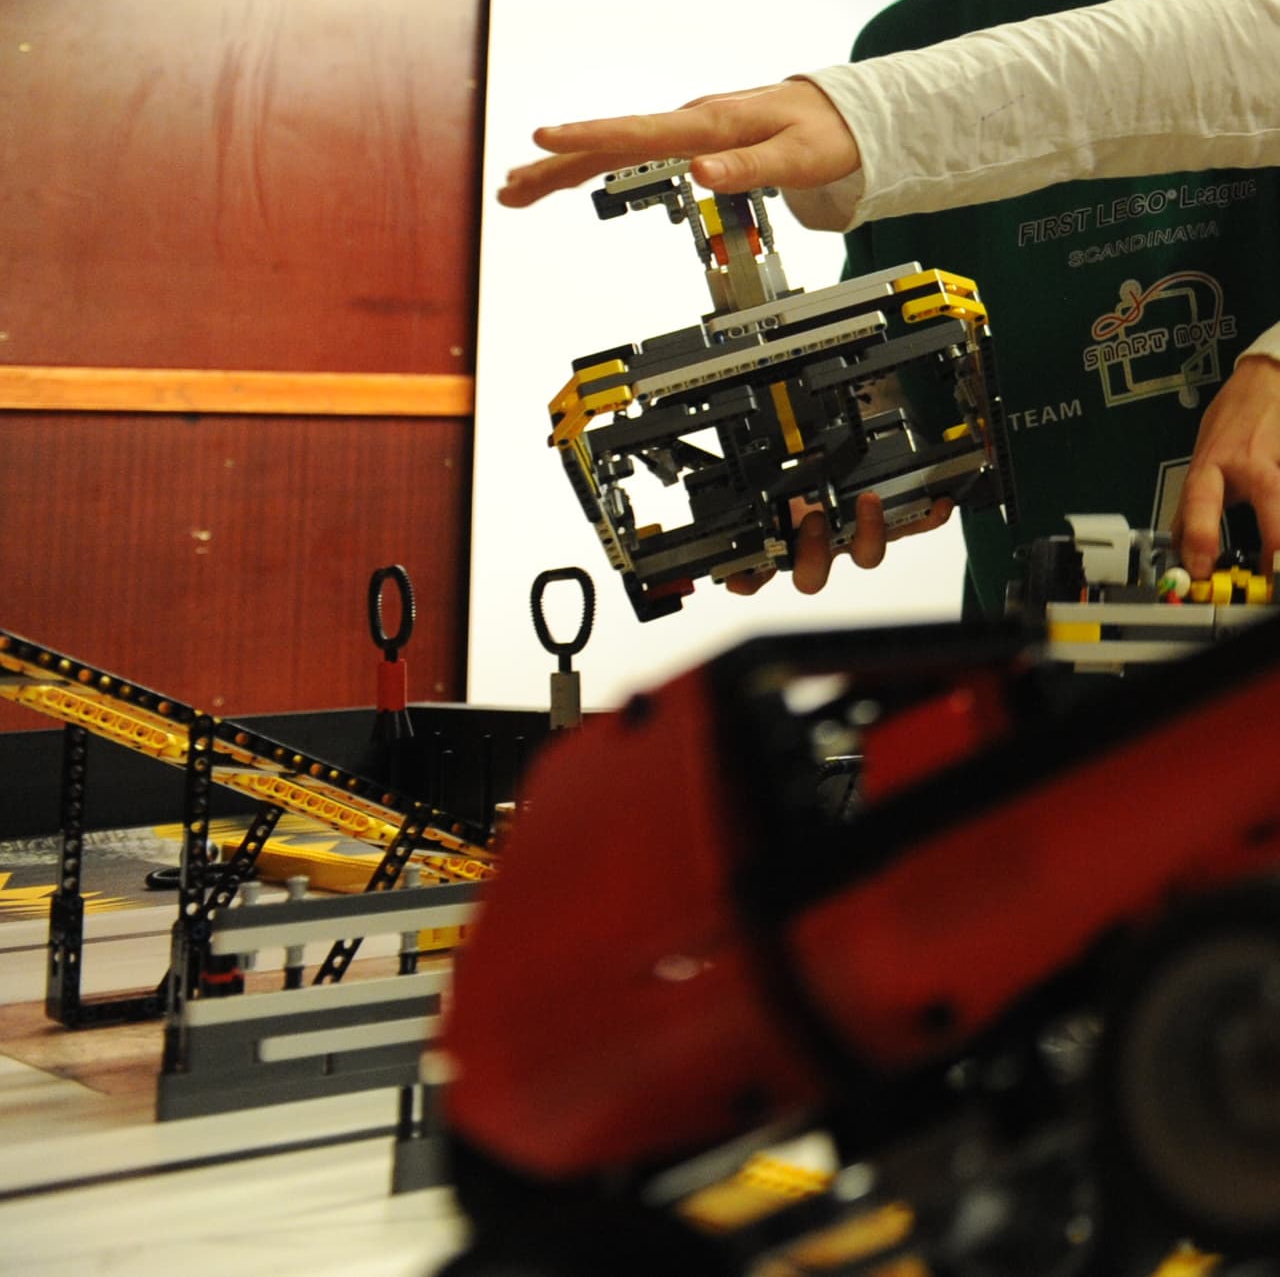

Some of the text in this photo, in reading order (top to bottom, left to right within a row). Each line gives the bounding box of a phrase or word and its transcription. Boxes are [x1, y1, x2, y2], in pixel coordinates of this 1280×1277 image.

[1018, 207, 1092, 247] FIRST
[1179, 178, 1257, 209] League
[1068, 220, 1220, 268] SCANDINAVIA
[1083, 315, 1238, 372] SMART MOVE
[1008, 399, 1082, 432] TEAM
